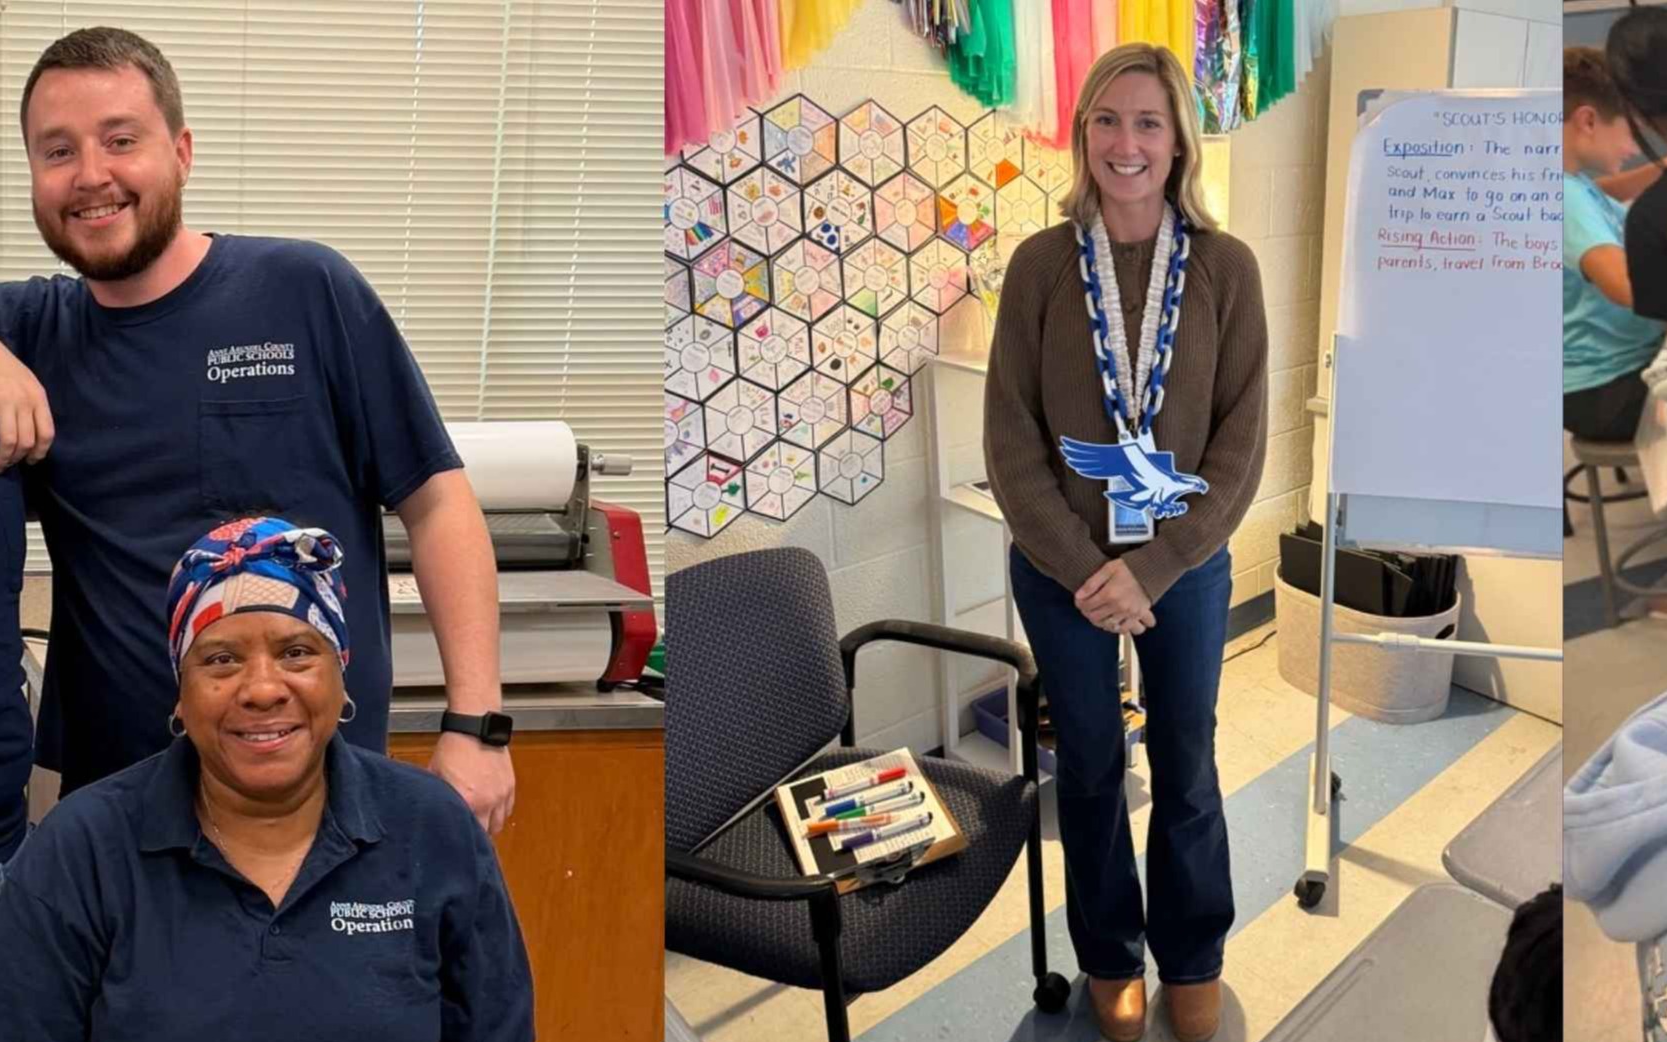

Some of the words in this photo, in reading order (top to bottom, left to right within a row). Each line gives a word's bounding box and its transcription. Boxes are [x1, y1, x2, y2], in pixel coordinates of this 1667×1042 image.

[1485, 140, 1511, 155] The
[1435, 168, 1506, 180] convinces
[1511, 167, 1536, 181] his
[1388, 186, 1416, 198] and
[1423, 186, 1456, 200] Max
[1467, 187, 1479, 201] to
[1485, 190, 1503, 208] go
[1510, 191, 1527, 201] on
[1531, 191, 1549, 201] an
[1389, 205, 1414, 223] trip
[1437, 210, 1469, 221] earn
[1476, 212, 1486, 222] a
[1493, 207, 1531, 221] Scout
[1378, 227, 1423, 250] Rising
[1493, 231, 1519, 249] The
[1525, 233, 1558, 255] boys
[1443, 257, 1484, 270] travel
[1492, 255, 1525, 270] from
[208, 353, 245, 366] PUBLIC
[245, 349, 295, 362] SCHOOLS
[207, 362, 295, 383] Operations
[330, 907, 366, 919] PUBLIC
[367, 905, 415, 918] SCHOOL
[331, 917, 414, 935] Operation
